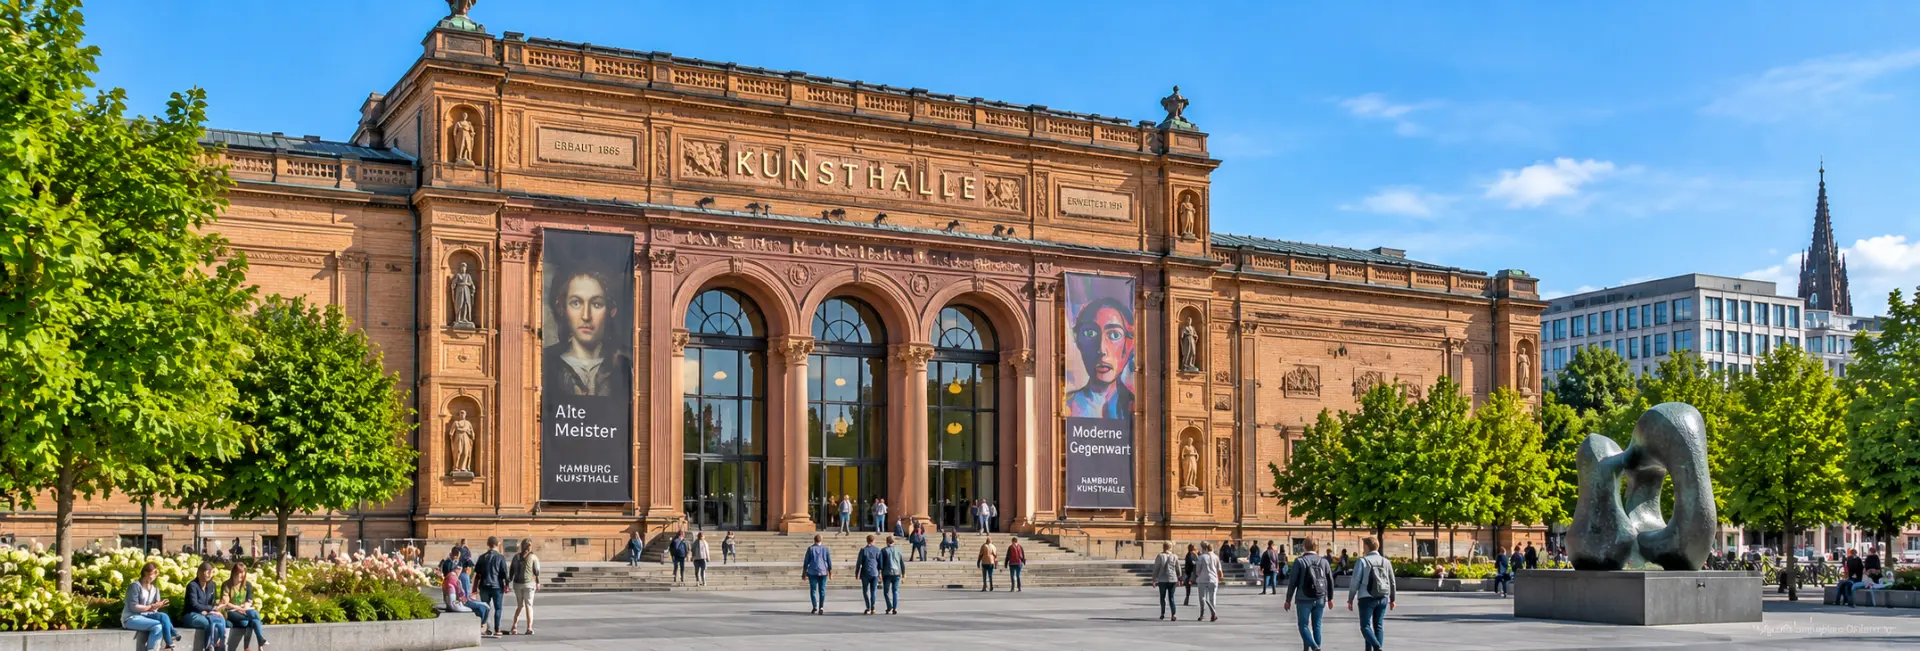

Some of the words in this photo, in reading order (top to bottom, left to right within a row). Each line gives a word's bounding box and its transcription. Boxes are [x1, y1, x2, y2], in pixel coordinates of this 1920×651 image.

[554, 141, 594, 153] ERBAUT
[736, 151, 977, 199] KUNSTHALLE
[555, 404, 586, 419] Alte
[555, 422, 617, 438] Meister
[1072, 425, 1122, 439] Moderne
[1069, 441, 1131, 457] Gegenwart
[559, 464, 611, 473] HAMBURG
[1081, 476, 1118, 485] HAMBURG
